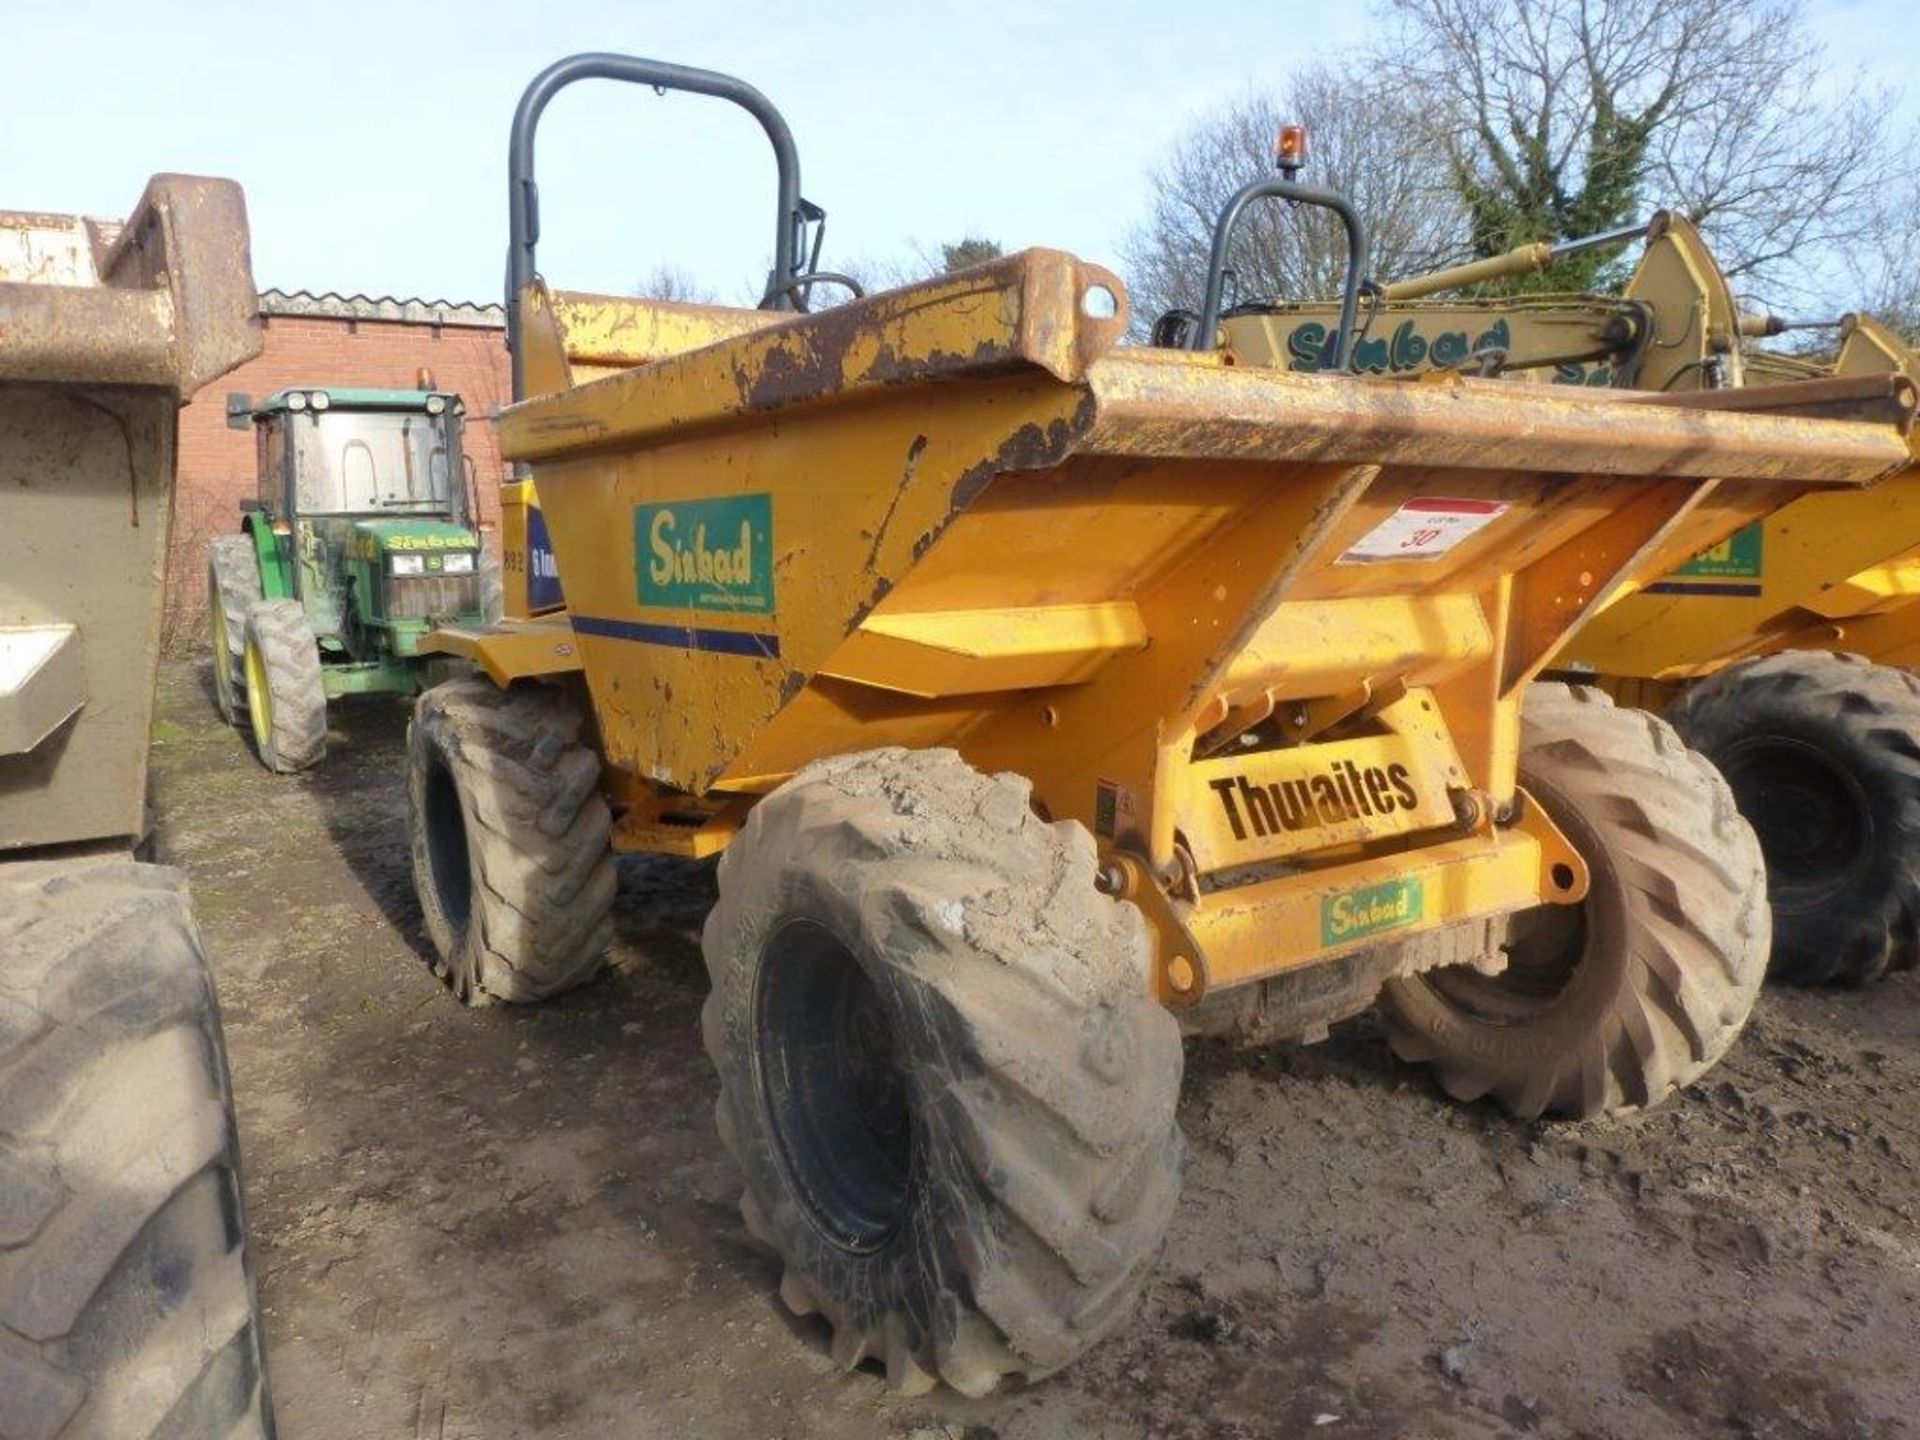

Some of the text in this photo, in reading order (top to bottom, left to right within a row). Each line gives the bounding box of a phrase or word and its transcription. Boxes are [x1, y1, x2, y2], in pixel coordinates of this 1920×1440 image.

[649, 509, 752, 586] Sinbad
[1400, 529, 1441, 548] 30
[1208, 760, 1418, 841] Thwaites
[1330, 887, 1409, 936] Sinbad
